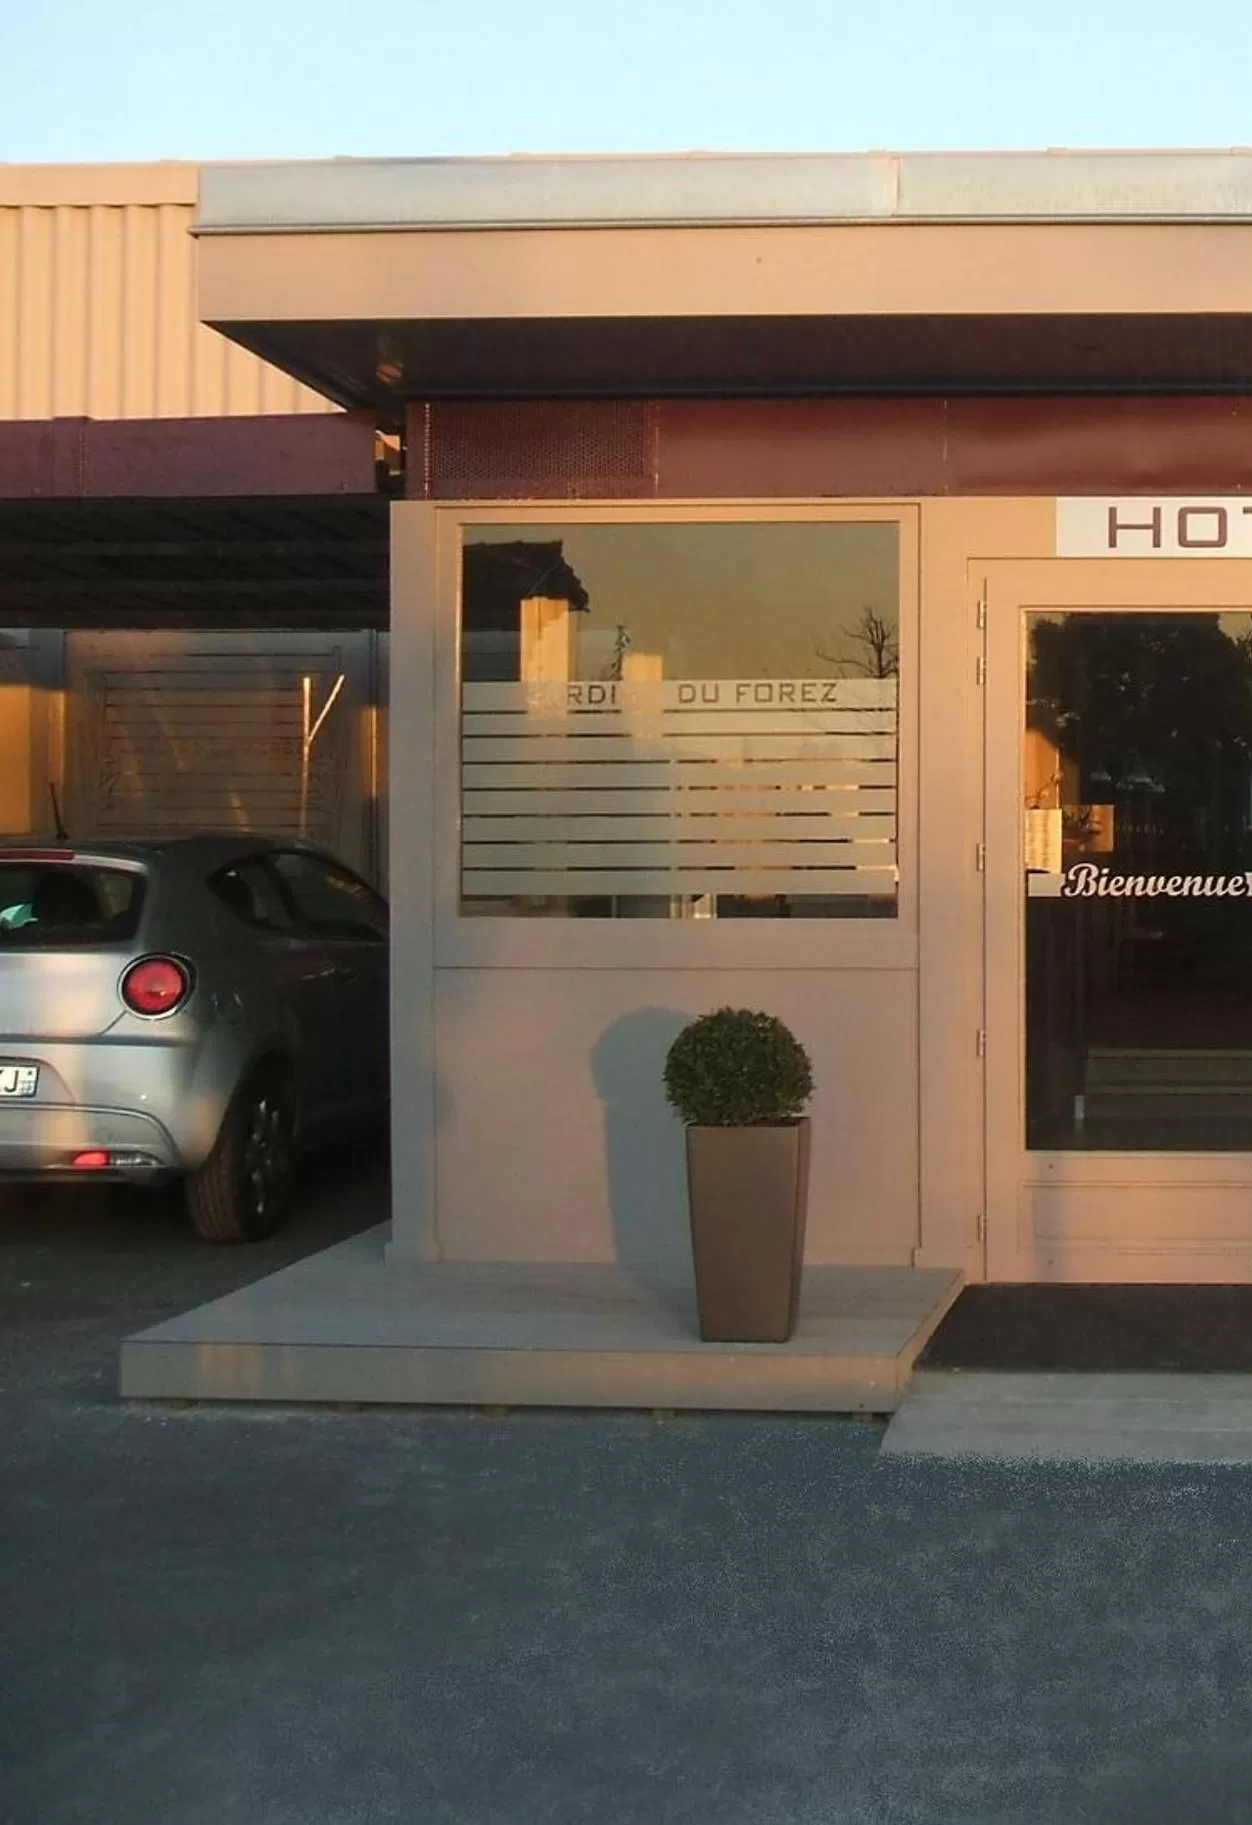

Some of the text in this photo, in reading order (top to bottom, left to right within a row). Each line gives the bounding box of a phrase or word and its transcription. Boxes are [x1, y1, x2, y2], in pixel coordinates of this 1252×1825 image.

[678, 683, 720, 703] DU
[735, 683, 838, 703] FOREZ
[1064, 863, 1247, 897] Bienvenue
